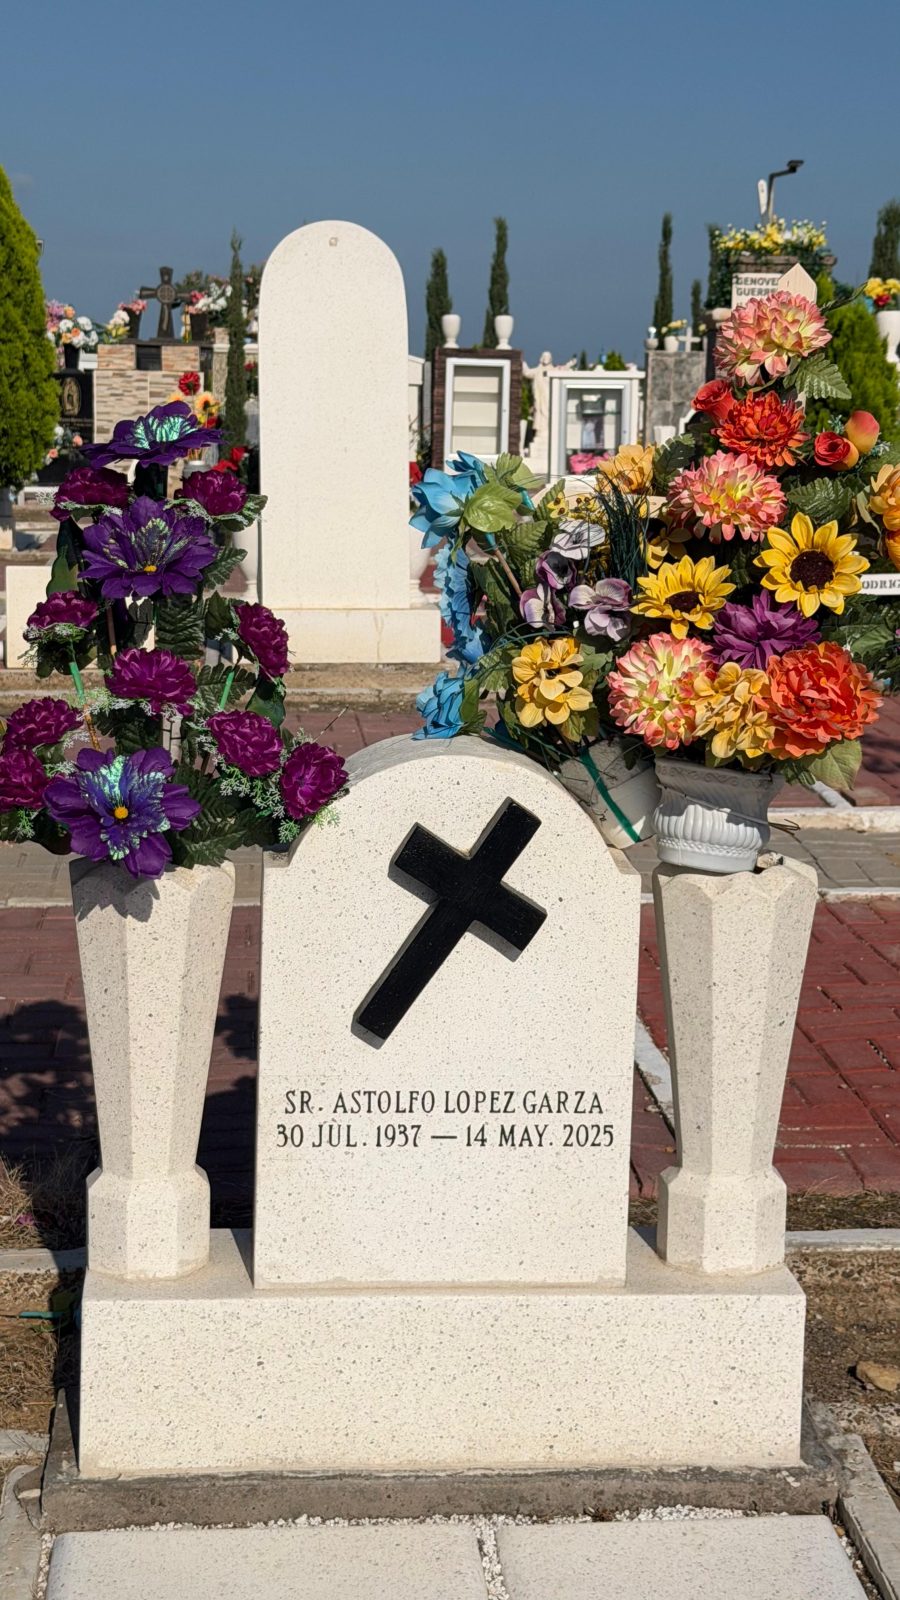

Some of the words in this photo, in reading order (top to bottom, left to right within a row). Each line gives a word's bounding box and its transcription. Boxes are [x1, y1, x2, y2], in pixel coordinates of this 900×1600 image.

[736, 276, 779, 286] GENOVE
[860, 578, 900, 590] ODRIG
[284, 1090, 323, 1114] SR.
[332, 1090, 435, 1114] ASTOLFO
[443, 1090, 516, 1114] LOPEZ
[522, 1090, 605, 1114] GARZA
[277, 1124, 304, 1147] 30
[312, 1124, 367, 1147] JUL.
[375, 1124, 422, 1147] 1937
[466, 1124, 488, 1147] 14
[498, 1124, 553, 1147] MAY.
[562, 1124, 614, 1147] 2025
